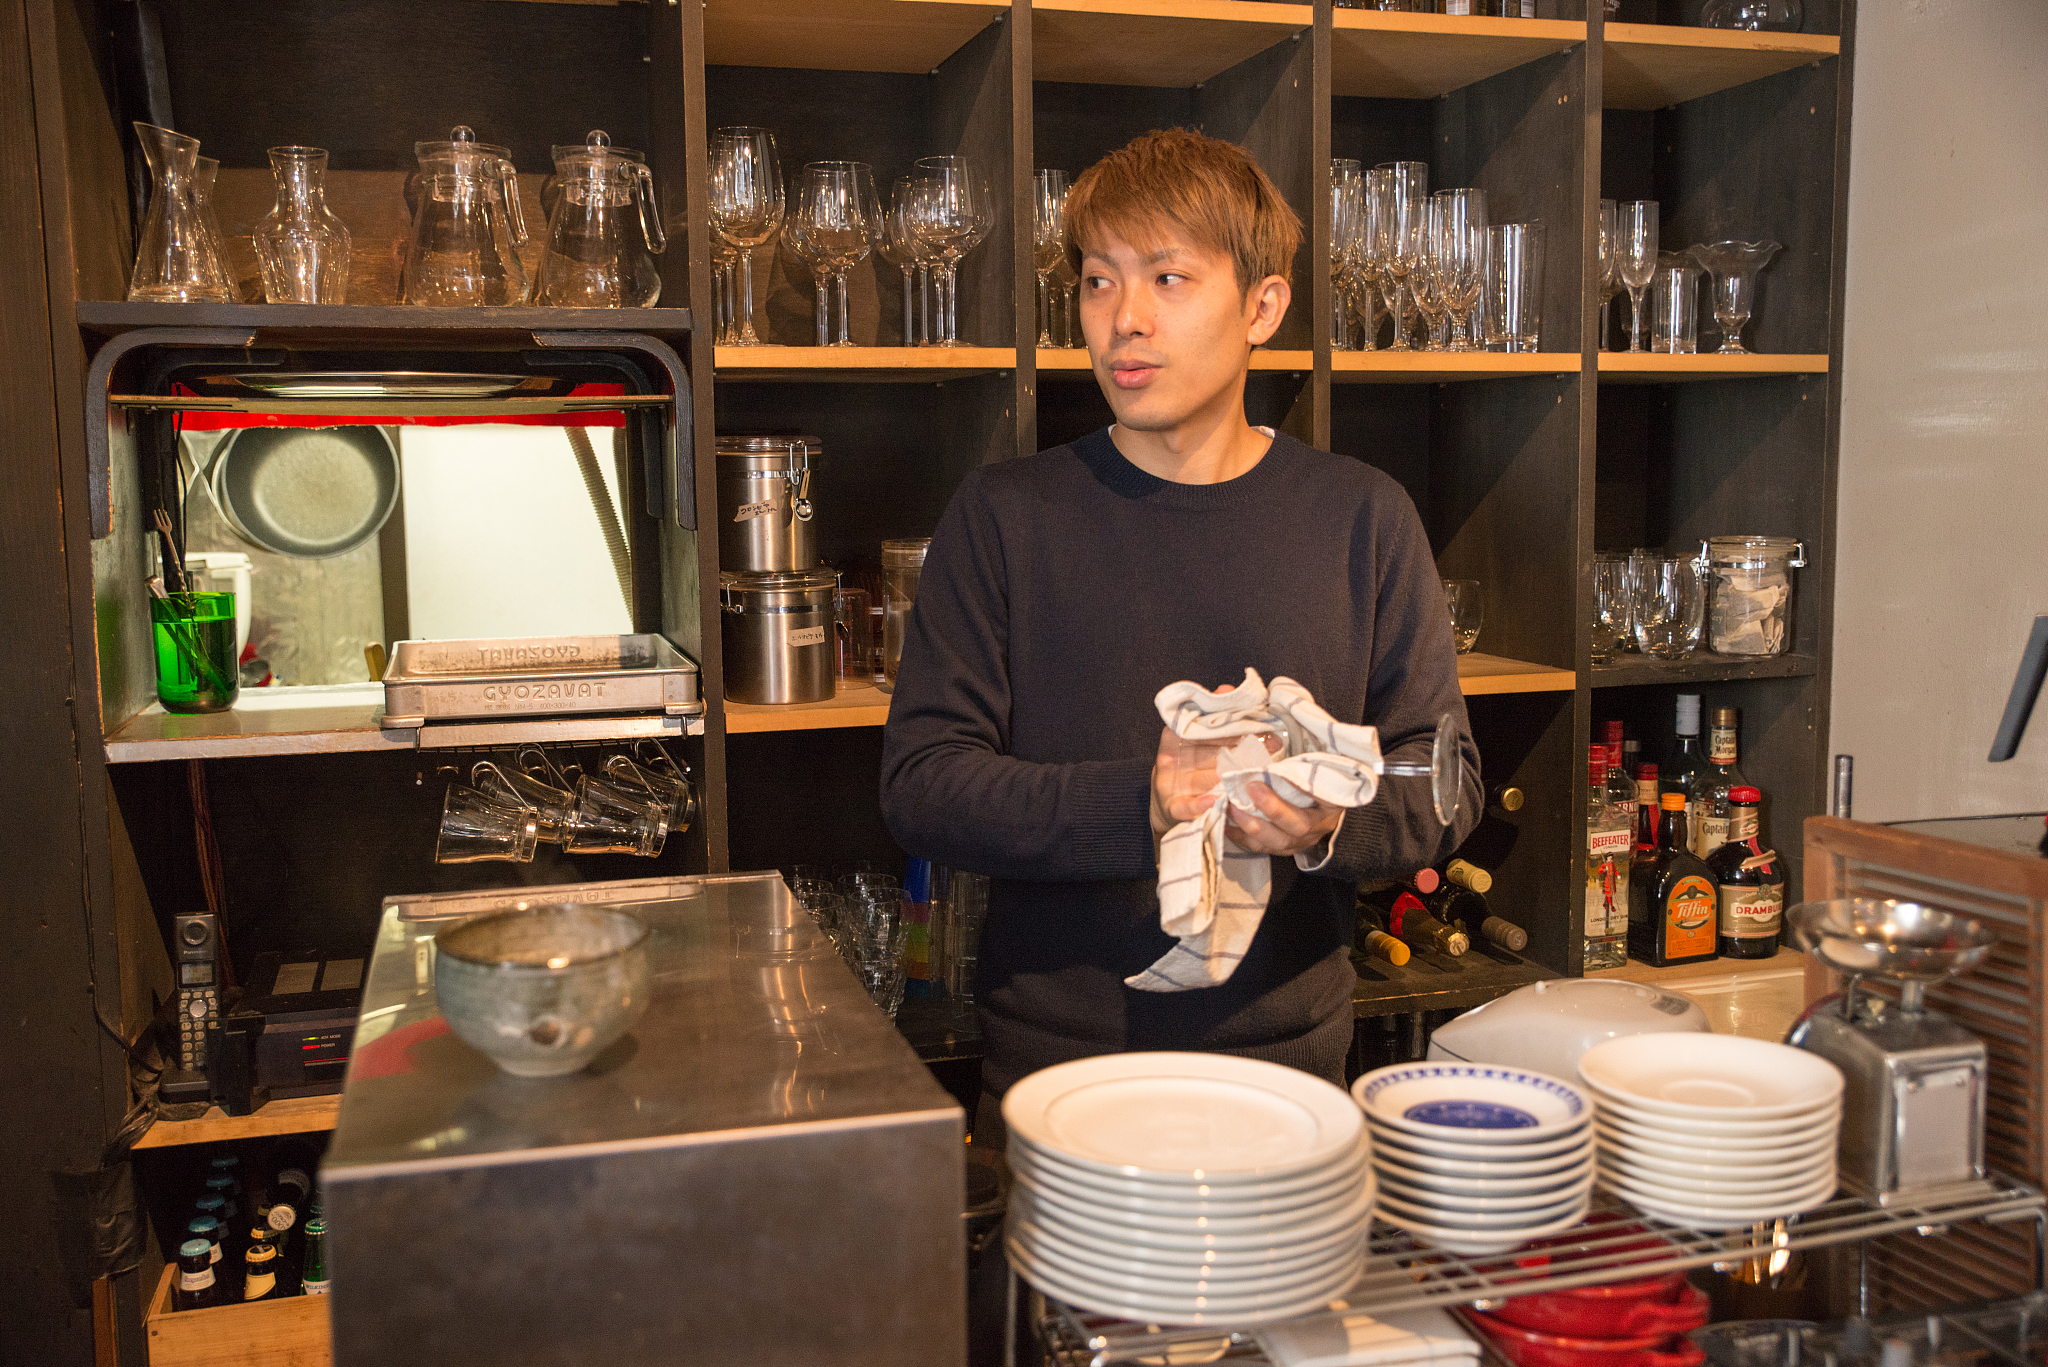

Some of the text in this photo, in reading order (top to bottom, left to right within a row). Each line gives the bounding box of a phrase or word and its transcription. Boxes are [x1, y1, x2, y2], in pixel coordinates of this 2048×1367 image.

[483, 682, 606, 703] GYOZAVAT
[1592, 834, 1629, 850] BEEFEATER
[1676, 900, 1709, 919] Tiffin
